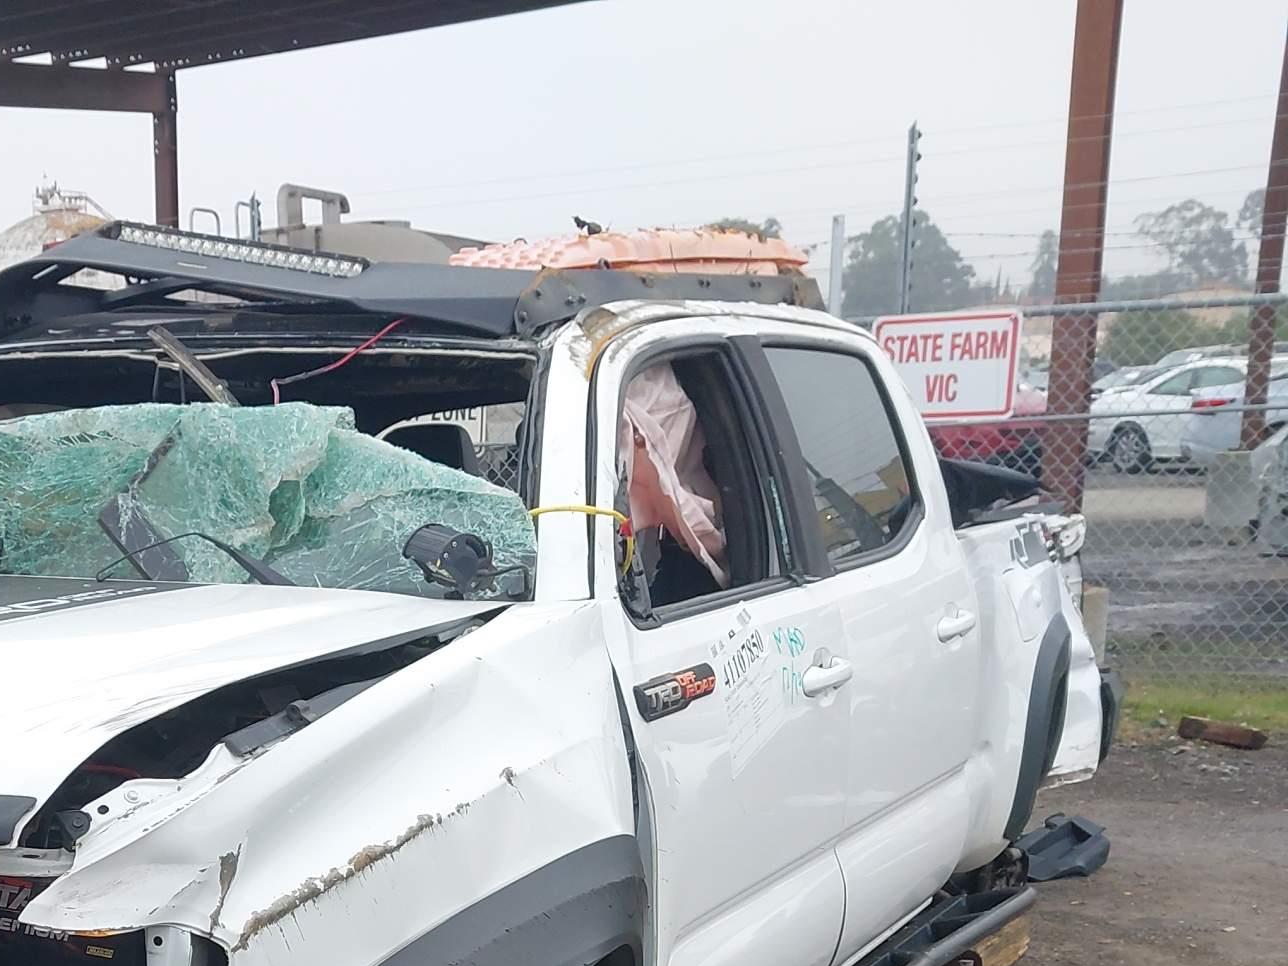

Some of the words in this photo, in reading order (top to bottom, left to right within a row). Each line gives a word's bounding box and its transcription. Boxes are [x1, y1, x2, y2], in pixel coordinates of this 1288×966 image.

[883, 333, 944, 364] STATE
[949, 329, 1009, 361] FARM
[925, 373, 958, 403] VIC
[722, 628, 765, 689] 41107850
[643, 680, 682, 712] TRD
